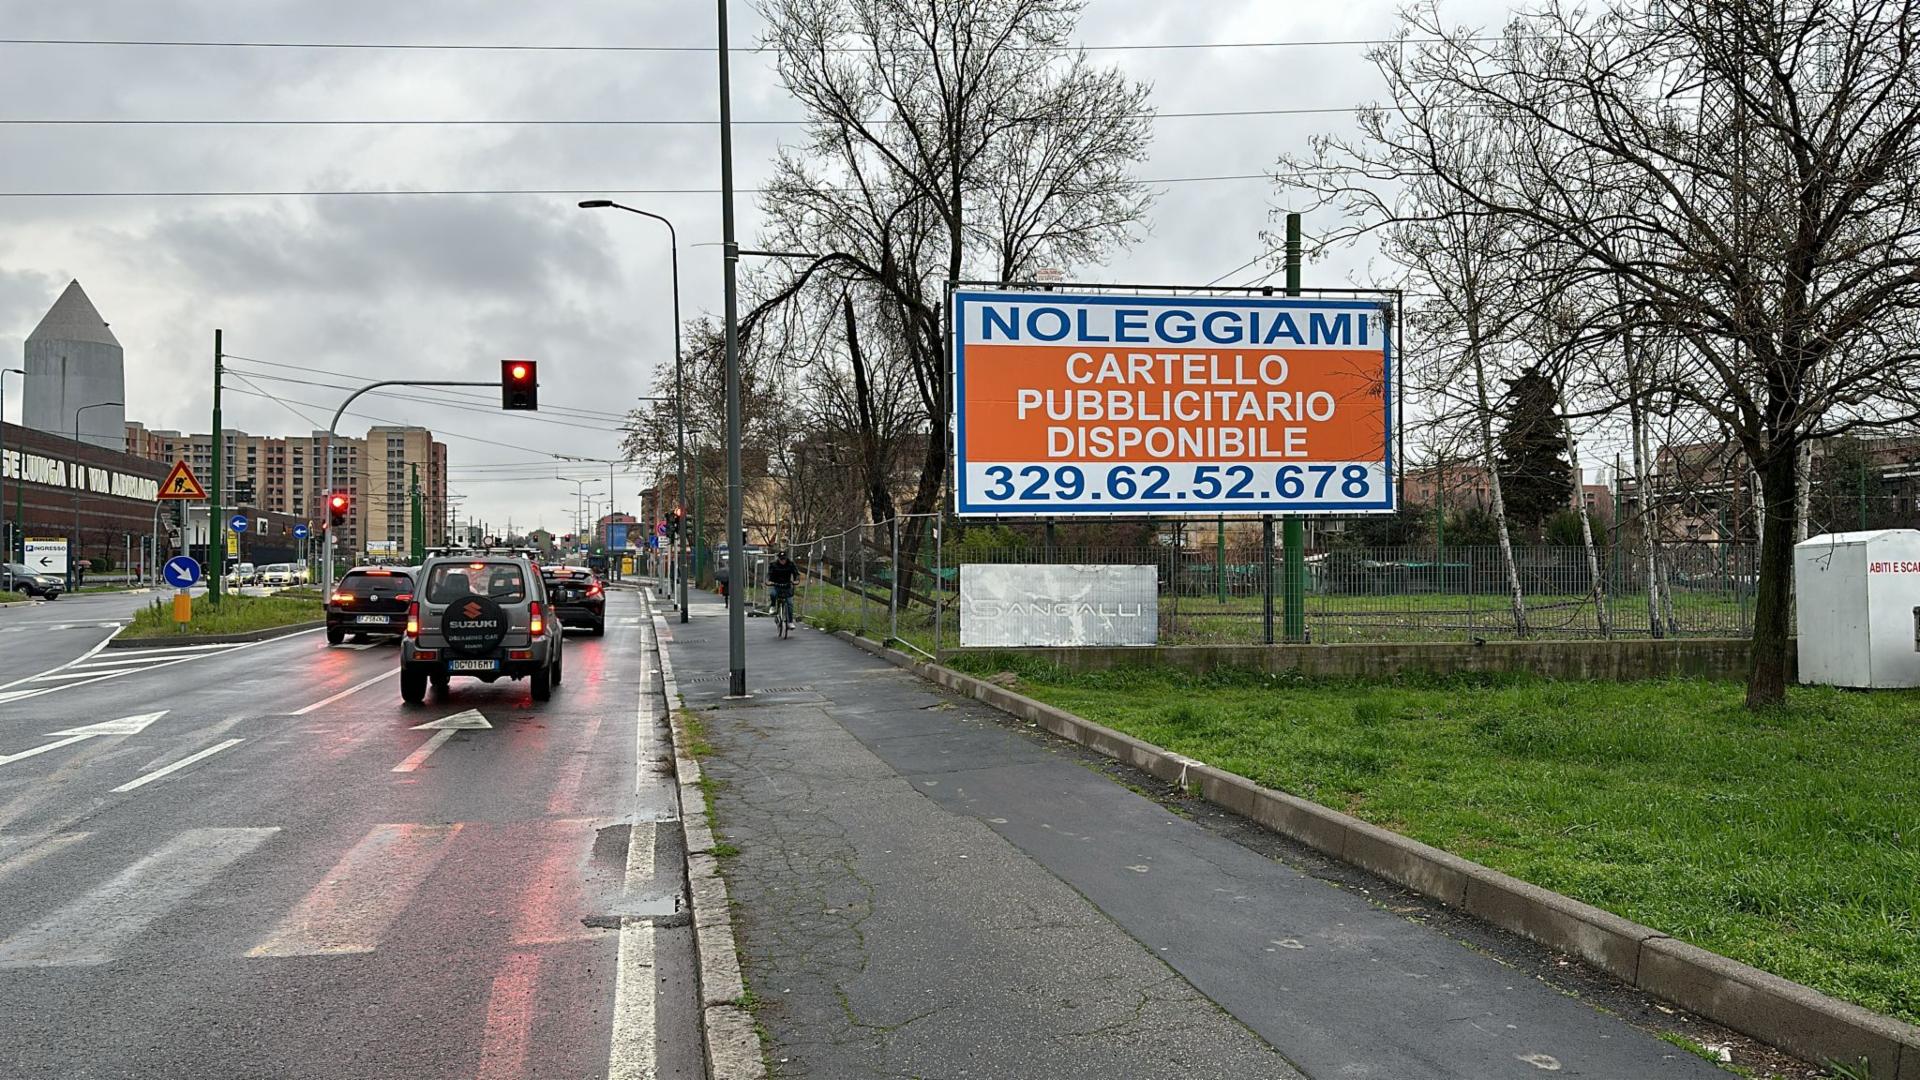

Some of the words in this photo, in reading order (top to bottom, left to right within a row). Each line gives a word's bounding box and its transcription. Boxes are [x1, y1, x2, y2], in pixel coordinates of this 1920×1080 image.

[982, 306, 1368, 346] NOLEGGIAMI
[1066, 352, 1289, 385] CARTELLO
[1018, 389, 1336, 422] PUBBLICITARIO
[1048, 426, 1308, 458] DISPONIBILE
[88, 467, 110, 494] VIA
[111, 472, 158, 502] ADRIANO
[983, 464, 1370, 502] 329.62.52.678
[1870, 562, 1891, 573] ABITI
[1893, 562, 1899, 573] E
[449, 620, 497, 629] SUZUKI
[969, 602, 1141, 620] SANGALLI
